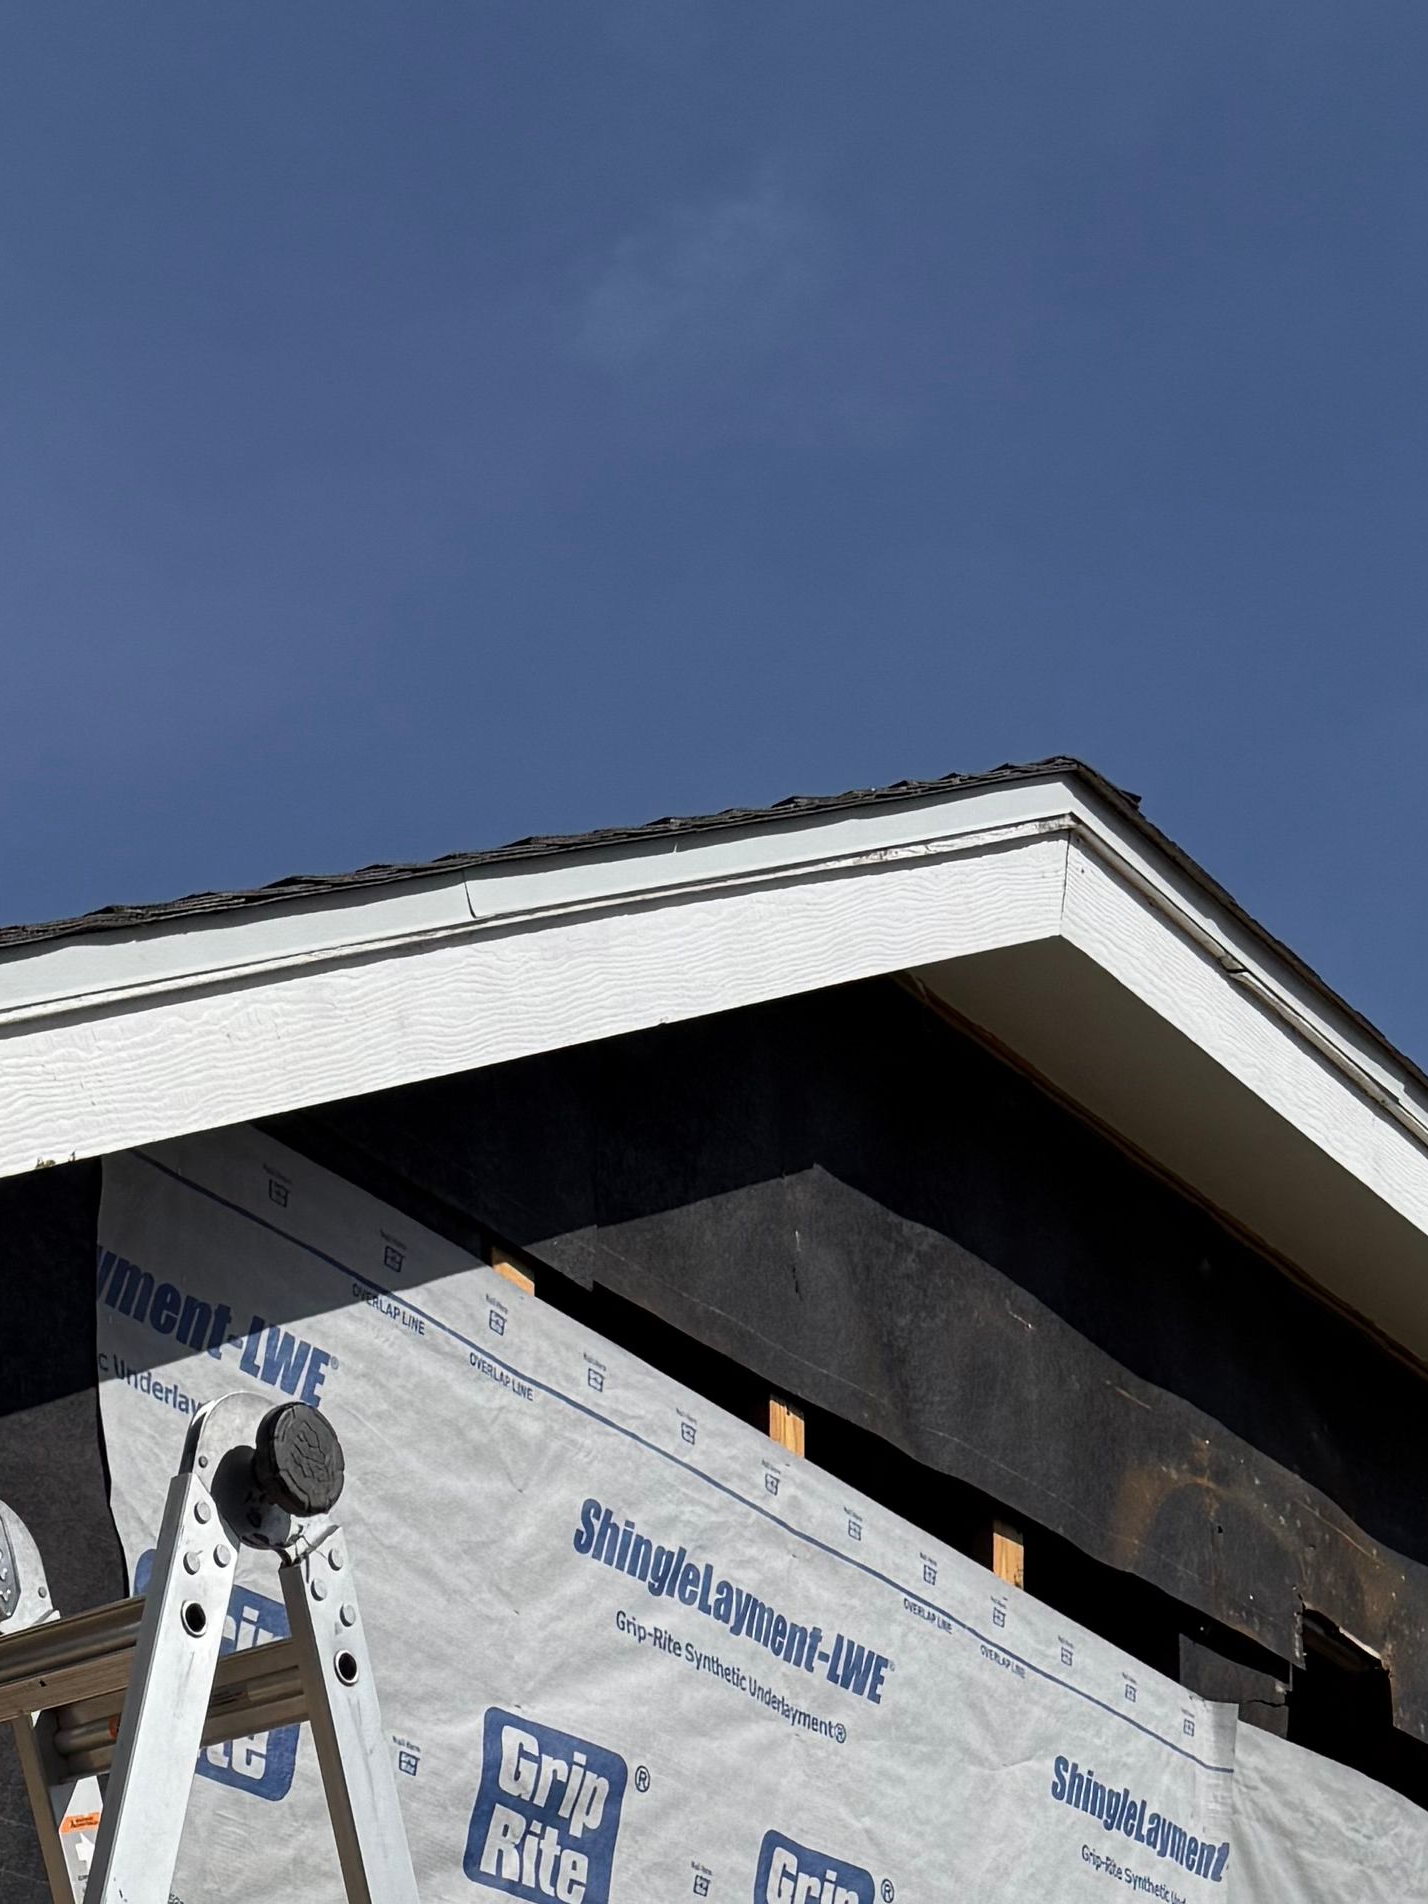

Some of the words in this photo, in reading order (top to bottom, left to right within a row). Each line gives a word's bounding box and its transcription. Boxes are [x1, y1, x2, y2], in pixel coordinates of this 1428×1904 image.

[352, 1283, 401, 1321] OVERLAP
[401, 1312, 425, 1336] LINE
[469, 1352, 512, 1394] OVERLAP
[512, 1380, 534, 1402] LINE
[573, 1498, 890, 1705] ShingleLayment-LWE
[615, 1610, 683, 1658] Grip-Rite
[684, 1642, 748, 1692] Synthetic
[498, 1725, 610, 1838] Grip
